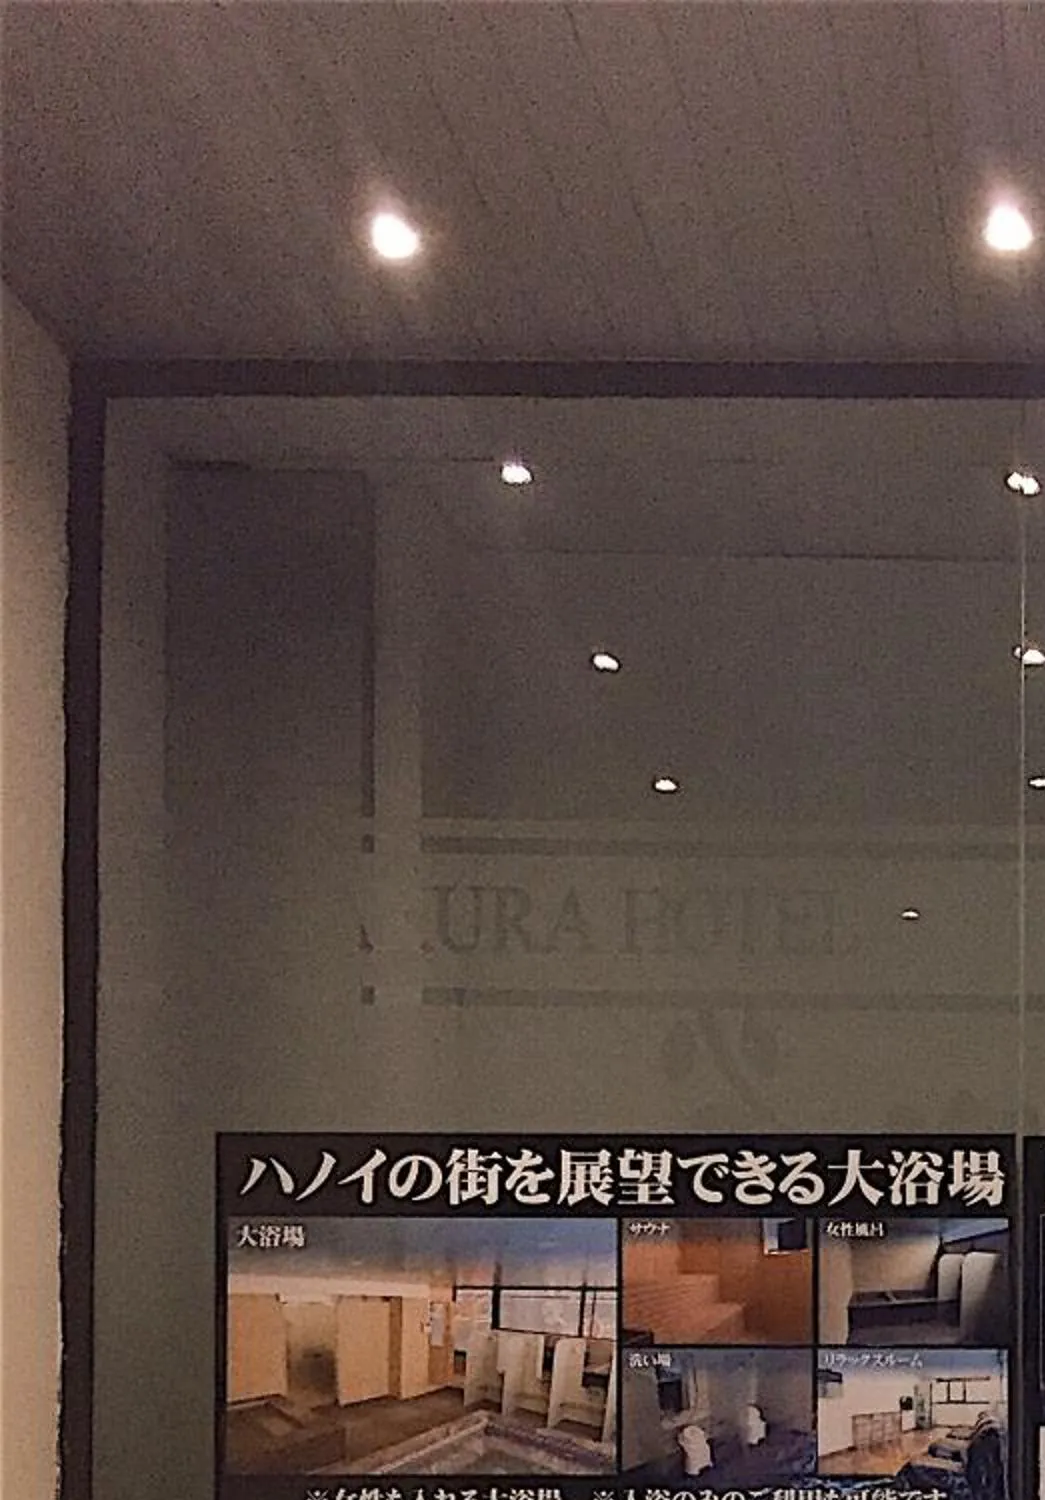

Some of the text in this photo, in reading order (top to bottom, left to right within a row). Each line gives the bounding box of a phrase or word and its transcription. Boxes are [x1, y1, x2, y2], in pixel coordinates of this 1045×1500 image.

[359, 883, 598, 956] URA
[240, 1148, 1005, 1206] ハノイの街を展望できる大浴場
[236, 1225, 305, 1248] 大浴場
